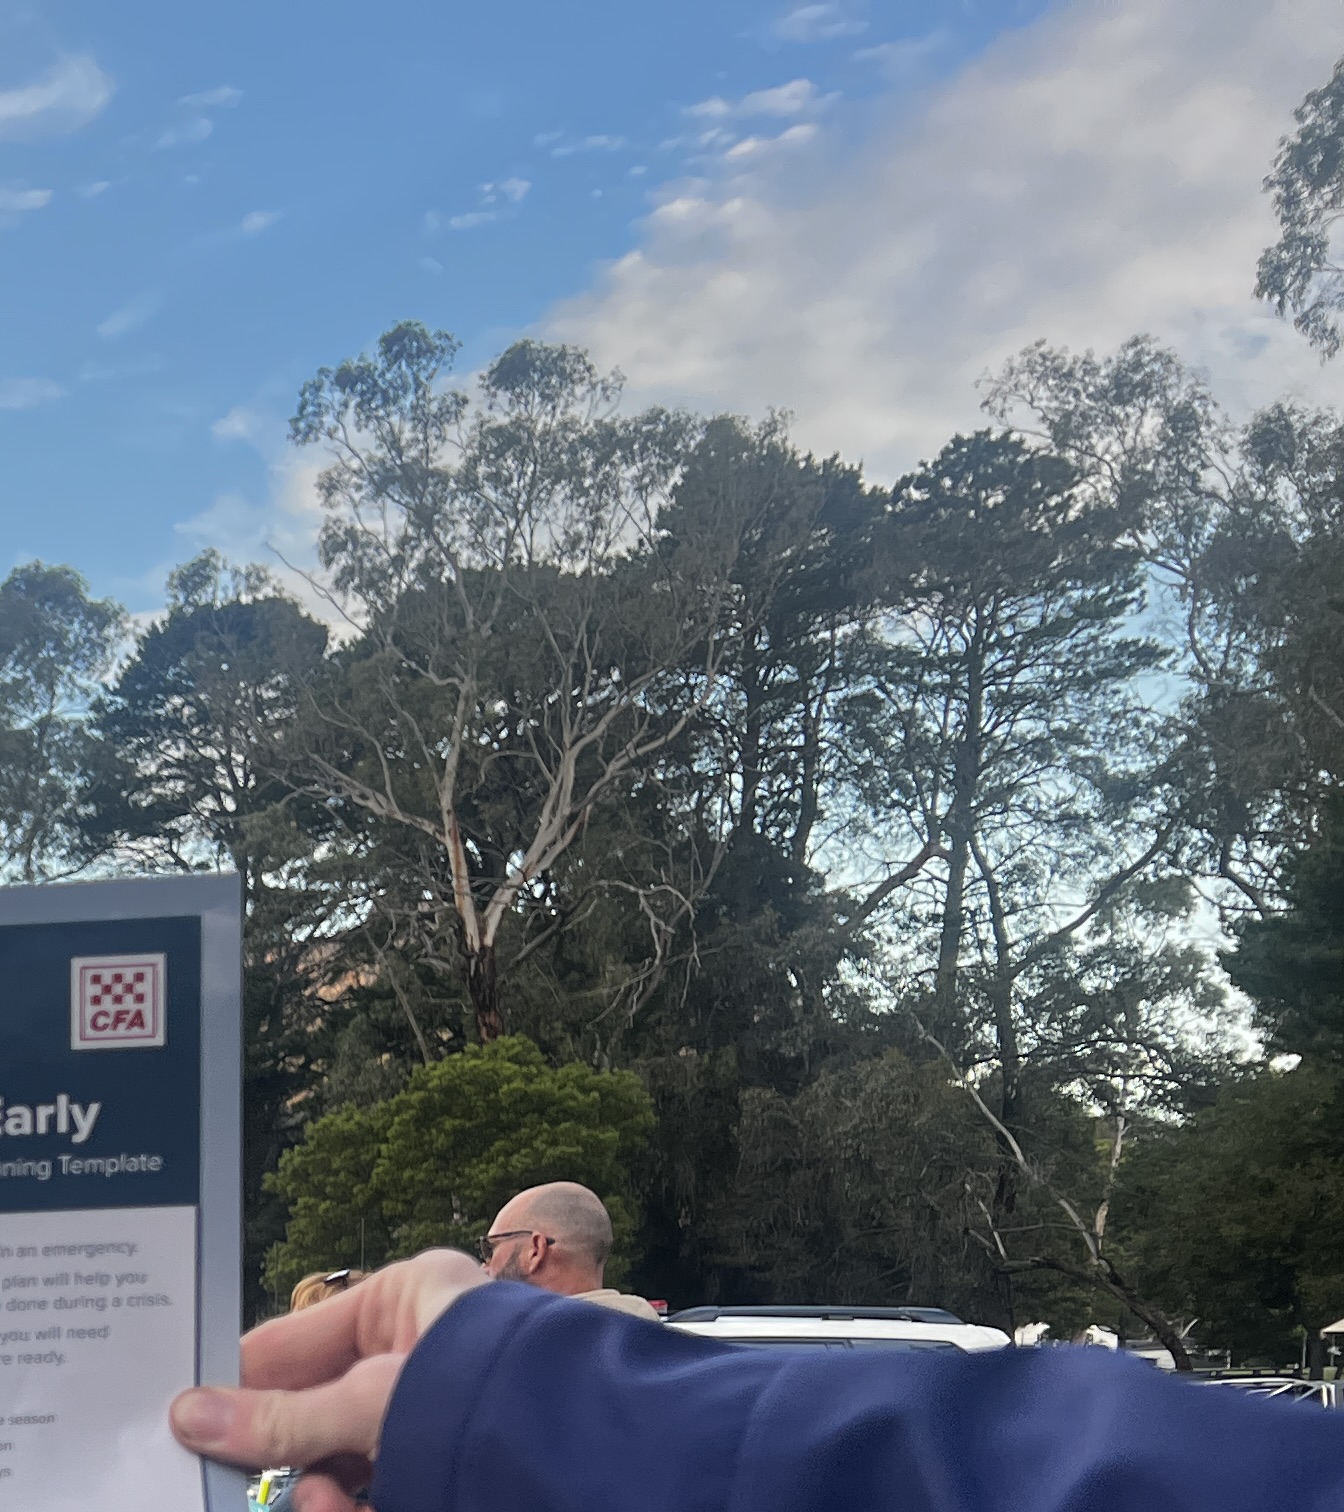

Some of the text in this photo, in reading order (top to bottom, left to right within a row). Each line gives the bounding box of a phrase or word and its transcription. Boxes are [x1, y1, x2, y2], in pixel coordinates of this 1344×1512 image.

[90, 1009, 145, 1032] CFA
[58, 1152, 163, 1176] Template
[16, 1245, 37, 1257] an
[1, 1274, 37, 1290] plan
[43, 1272, 69, 1286] will
[73, 1270, 110, 1287] help
[115, 1272, 147, 1287] you
[6, 1297, 47, 1311] done
[53, 1294, 107, 1313] during
[111, 1296, 121, 1307] a
[126, 1293, 172, 1307] crisis.
[0, 1329, 29, 1345] you
[35, 1326, 60, 1340] will
[66, 1324, 110, 1339] need
